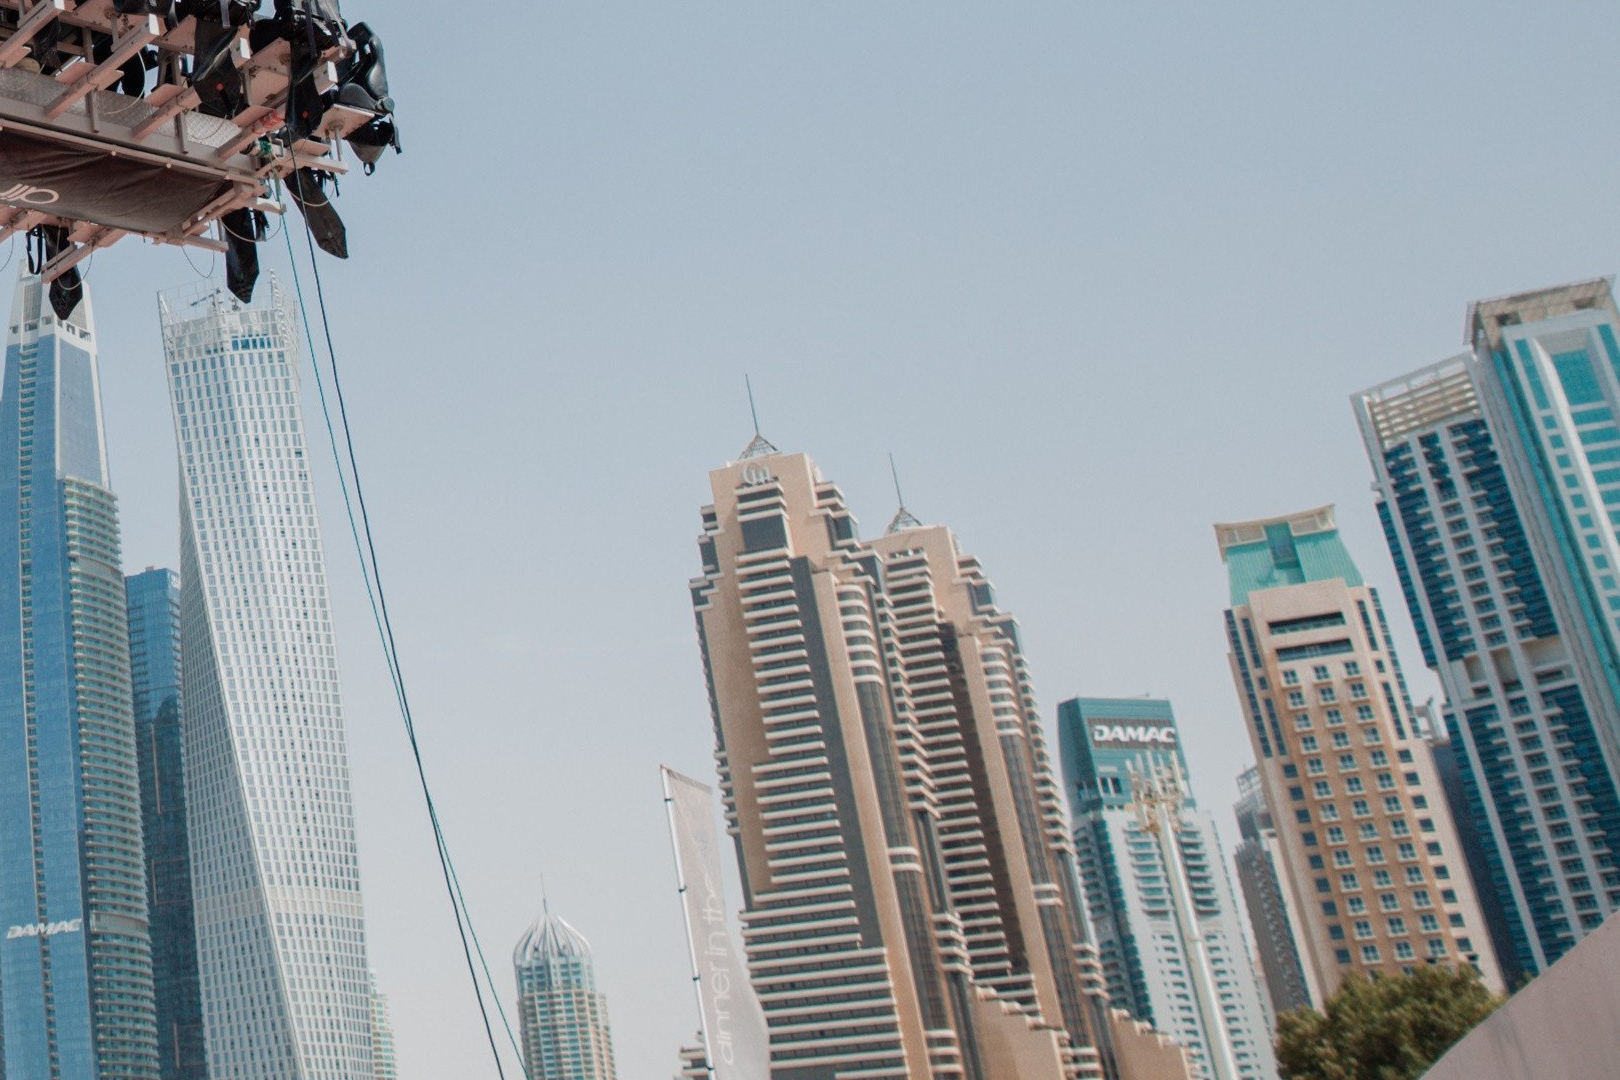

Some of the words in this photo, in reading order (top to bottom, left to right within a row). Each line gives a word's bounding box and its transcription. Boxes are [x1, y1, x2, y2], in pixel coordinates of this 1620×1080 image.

[1093, 724, 1176, 743] DAMAC
[7, 918, 82, 939] DAMAC
[704, 932, 728, 956] in
[709, 961, 734, 1065] dinner
